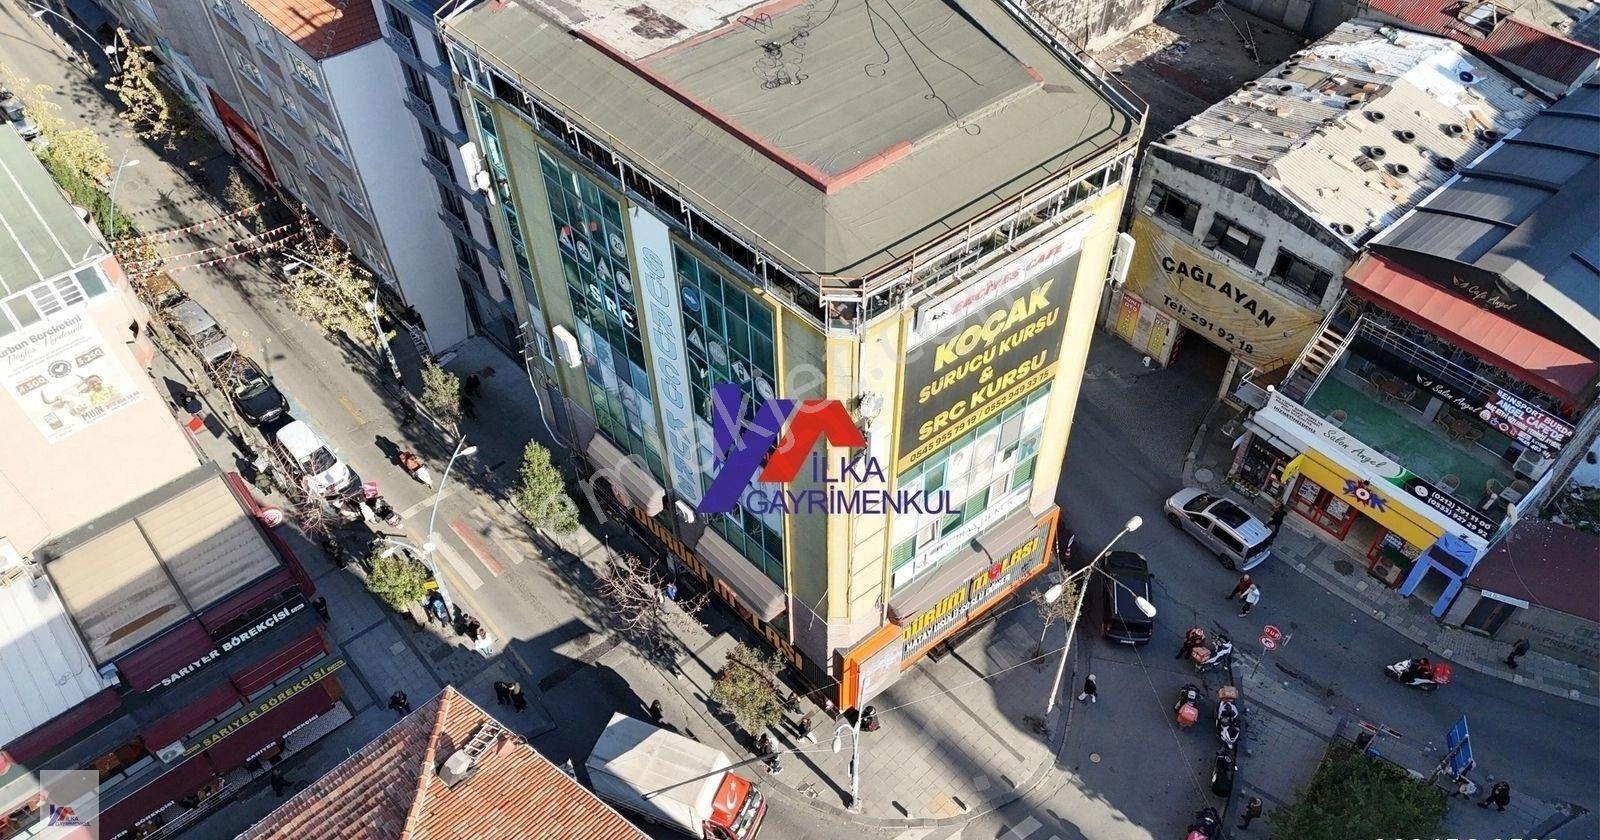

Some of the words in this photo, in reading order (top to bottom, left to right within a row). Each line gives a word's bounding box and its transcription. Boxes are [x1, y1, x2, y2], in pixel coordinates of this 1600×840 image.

[590, 283, 634, 328] SRC
[1487, 293, 1518, 311] Angel
[934, 279, 1056, 373] KOÇAK
[998, 307, 1060, 356] KURSU
[1164, 294, 1187, 315] Tel:
[1190, 312, 1214, 331] 291
[1217, 328, 1235, 344] 92
[1240, 340, 1254, 354] 18
[0, 340, 29, 359] urban
[979, 366, 994, 384] &
[918, 400, 967, 441] SRC
[970, 349, 1048, 409] KURSU
[1431, 381, 1453, 400] Salon
[1454, 394, 1483, 413] Angel
[1496, 399, 1525, 420] ANGEL
[910, 441, 934, 462] 0545
[935, 431, 952, 448] 955
[954, 422, 965, 436] 79
[967, 414, 976, 426] 19
[984, 396, 1007, 415] 0552
[1008, 386, 1025, 401] 949
[1543, 416, 1574, 437] BURDA
[1323, 429, 1350, 451] Salon
[1350, 446, 1388, 468] Angel
[1427, 497, 1452, 516] (0533)
[1432, 491, 1456, 509] (0212)
[1456, 506, 1470, 518] 291
[160, 649, 220, 687] SARIYER
[221, 606, 291, 652] BÖREKÇİSİ
[202, 710, 258, 747] SARIYER
[260, 667, 326, 712] BÖREKÇİSİ
[246, 741, 277, 762] SARIYER
